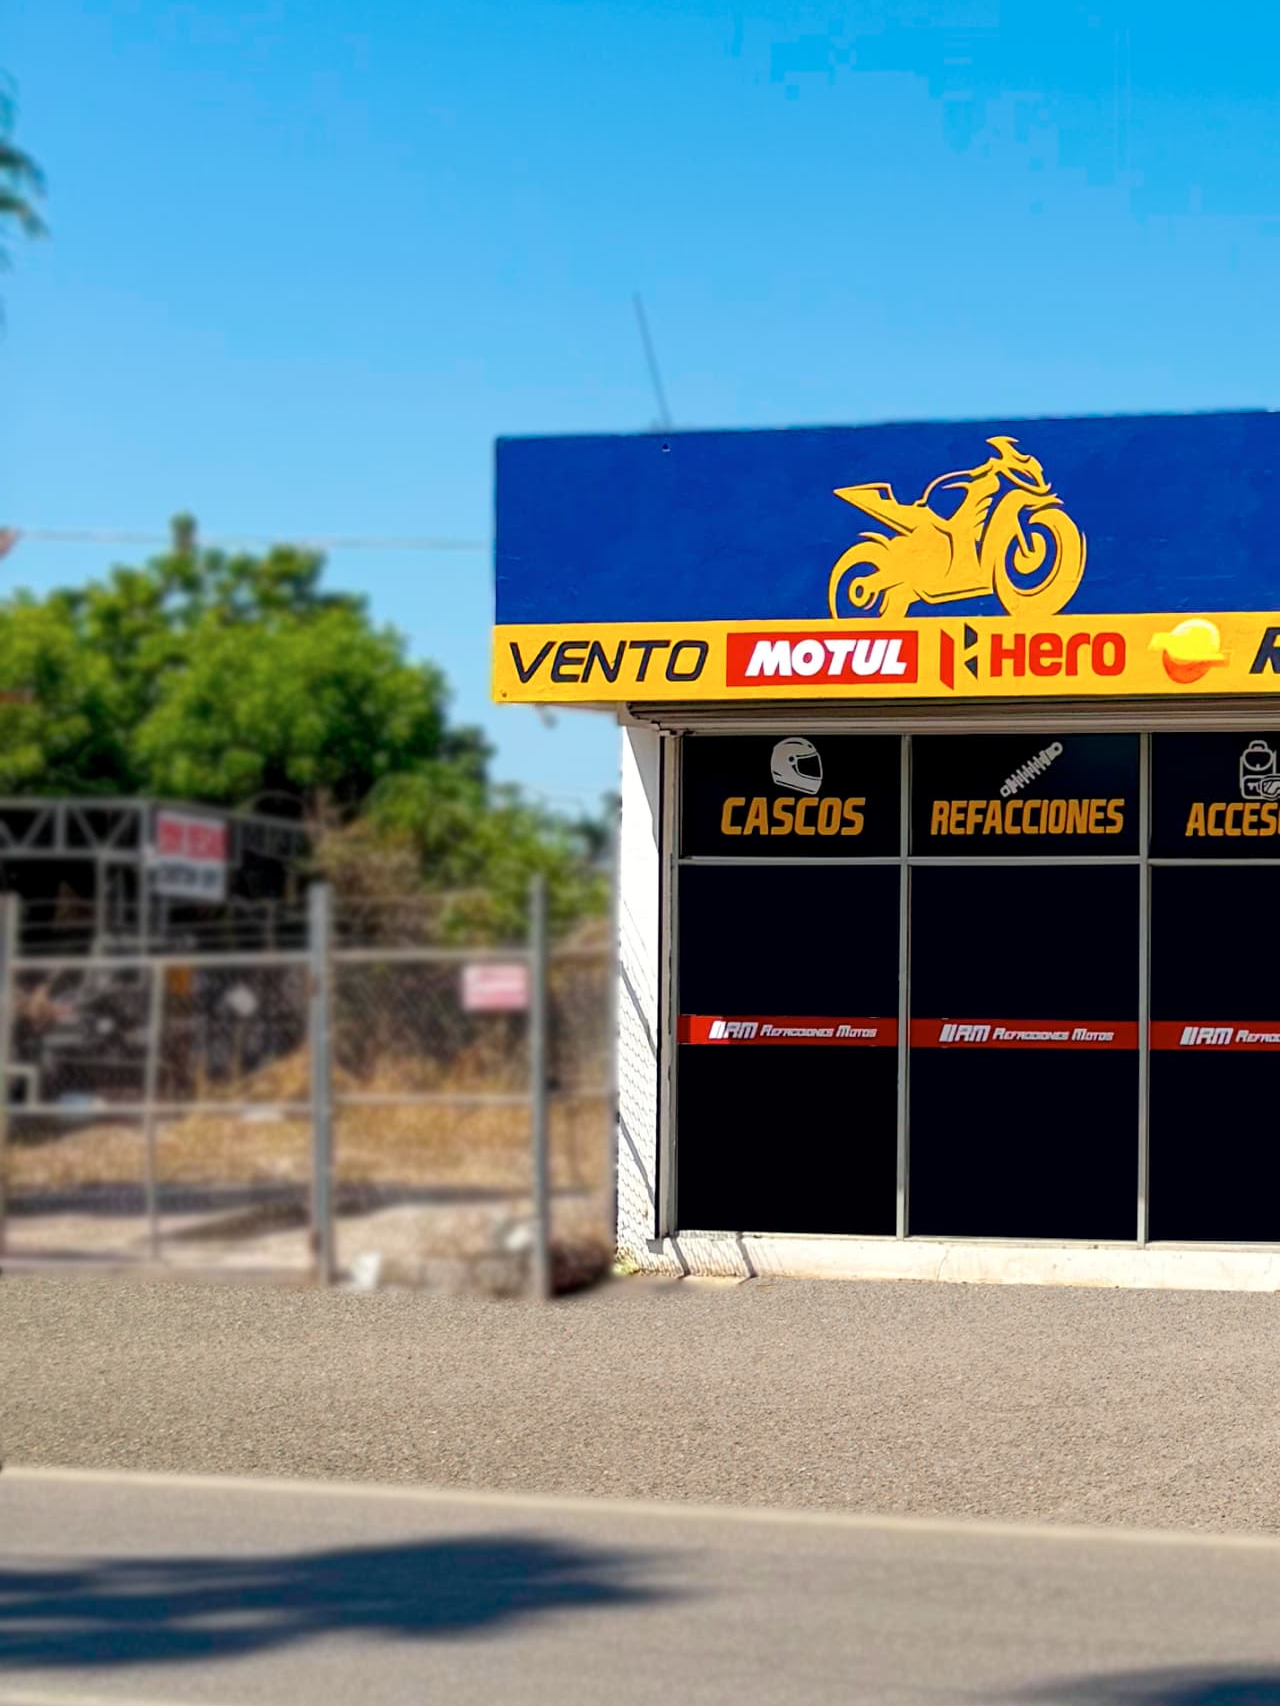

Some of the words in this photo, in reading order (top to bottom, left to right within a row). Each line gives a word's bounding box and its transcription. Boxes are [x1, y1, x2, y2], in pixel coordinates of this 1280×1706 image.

[509, 639, 709, 683] VENTO
[745, 638, 908, 678] MOTUL
[720, 797, 866, 835] CASCOS
[930, 798, 1125, 835] REFACCIONES
